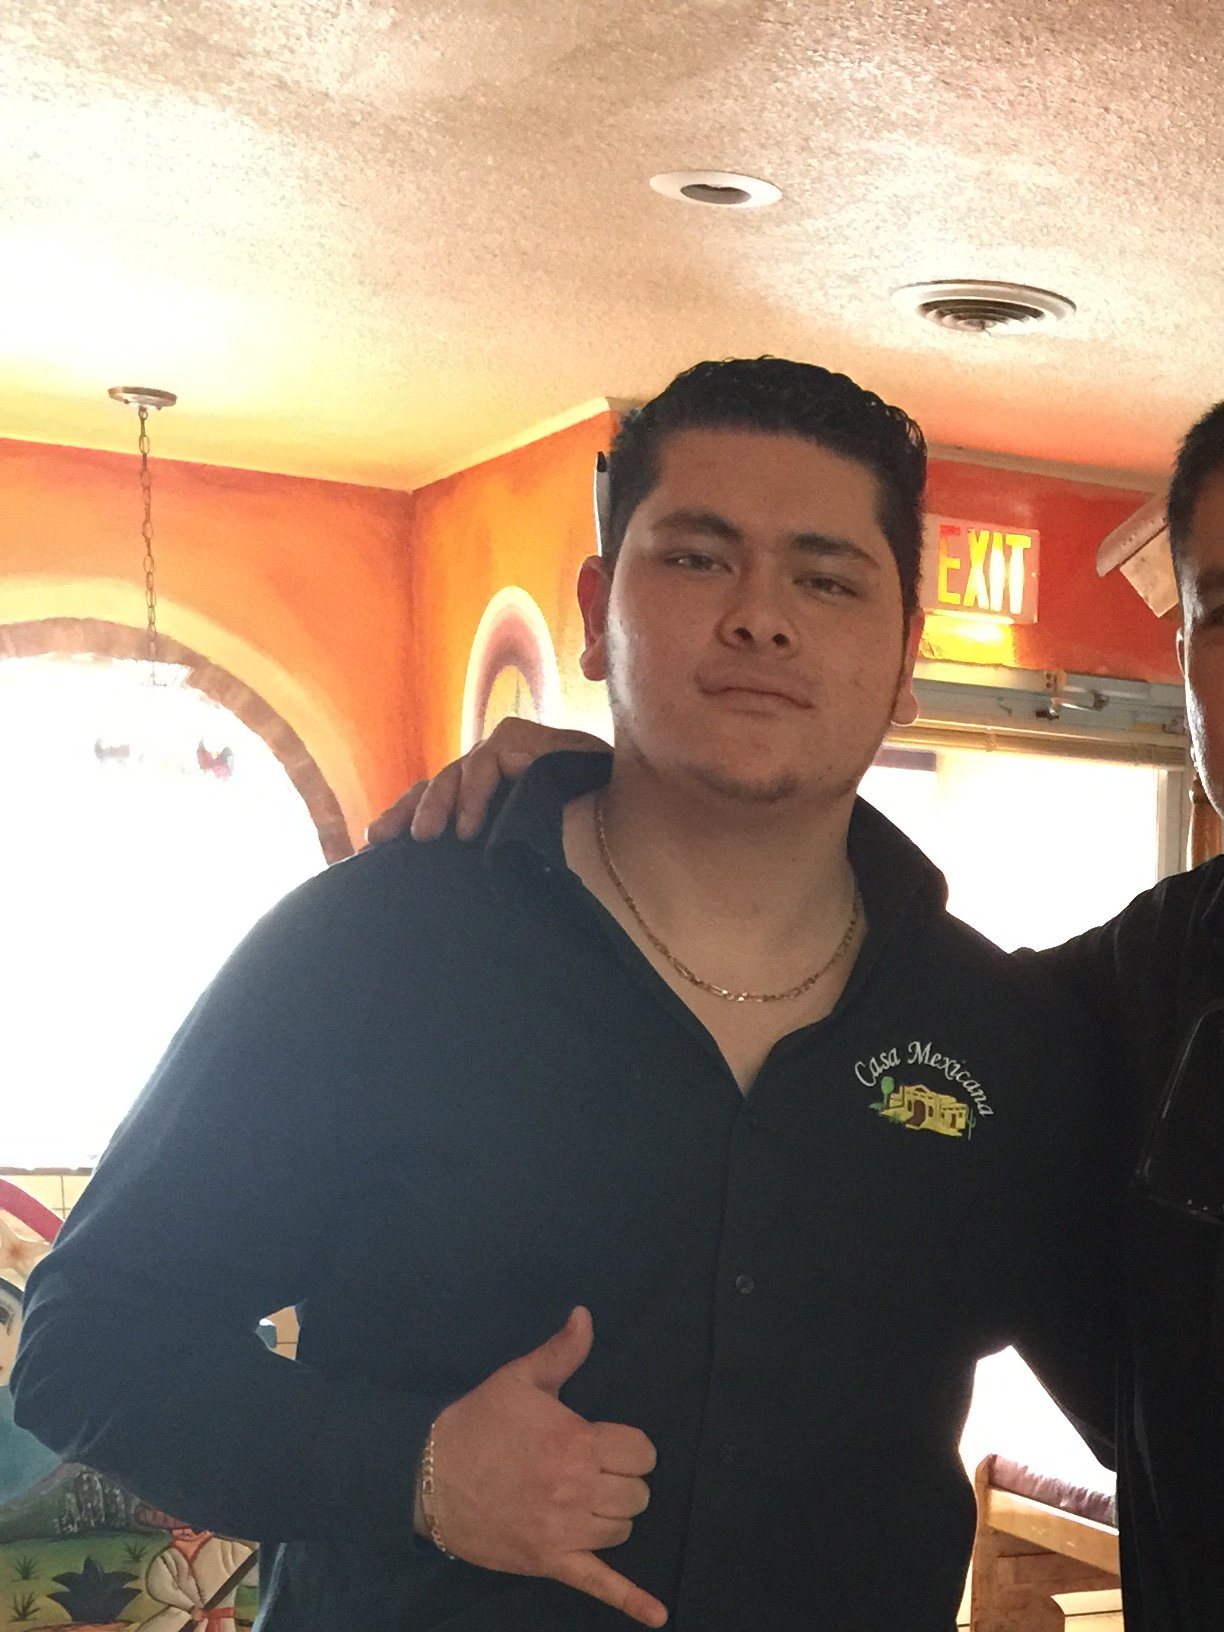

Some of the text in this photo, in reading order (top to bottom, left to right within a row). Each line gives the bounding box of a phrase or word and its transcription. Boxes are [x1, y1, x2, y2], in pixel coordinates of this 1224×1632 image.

[938, 525, 1032, 614] EXIT
[855, 1041, 995, 1117] Casa Mexicana
